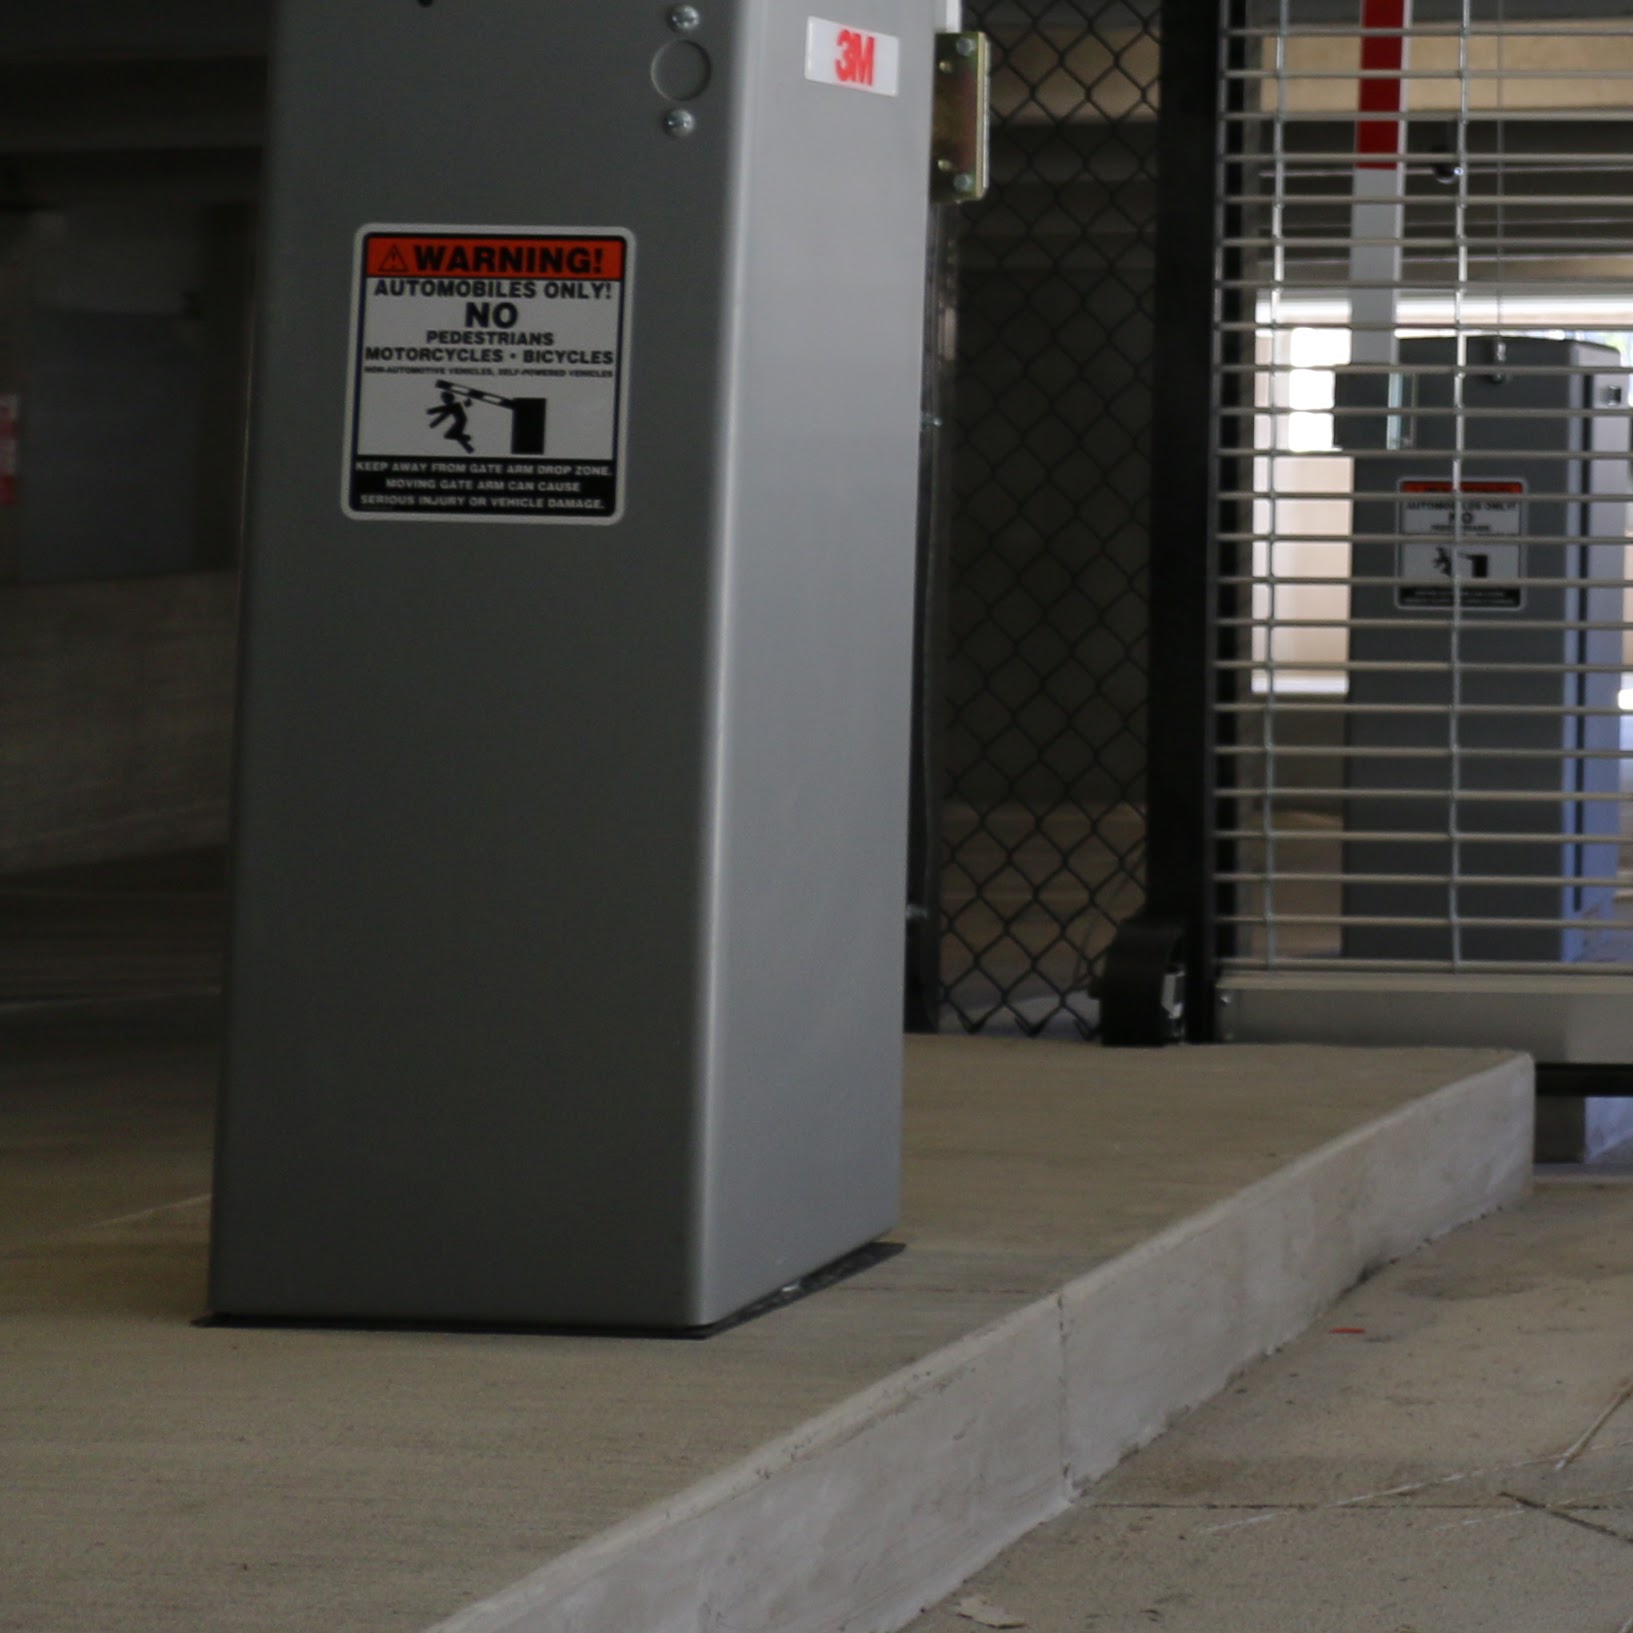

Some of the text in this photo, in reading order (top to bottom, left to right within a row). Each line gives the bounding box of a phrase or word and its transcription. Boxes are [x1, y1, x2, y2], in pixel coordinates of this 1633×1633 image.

[835, 29, 875, 86] 3M
[414, 245, 604, 274] WARNING!
[373, 279, 612, 300] AUTOMOBILES ONLY!
[465, 302, 519, 328] NO
[427, 330, 555, 346] PEDESTRIANS
[365, 347, 614, 365] MOTORCYCLES BICYCLES
[356, 461, 388, 472] KEEP
[391, 462, 428, 473] AWAY
[431, 463, 467, 474] FROM
[469, 463, 502, 474] GATE
[506, 464, 535, 475] ARM
[537, 465, 572, 475] DROP
[385, 478, 582, 492] MOVING GATE ARM CAN CAUSE
[360, 494, 415, 505] SERIOUS
[418, 495, 464, 506] INJURY
[469, 496, 488, 506] OR
[490, 497, 544, 508] VEHICLE
